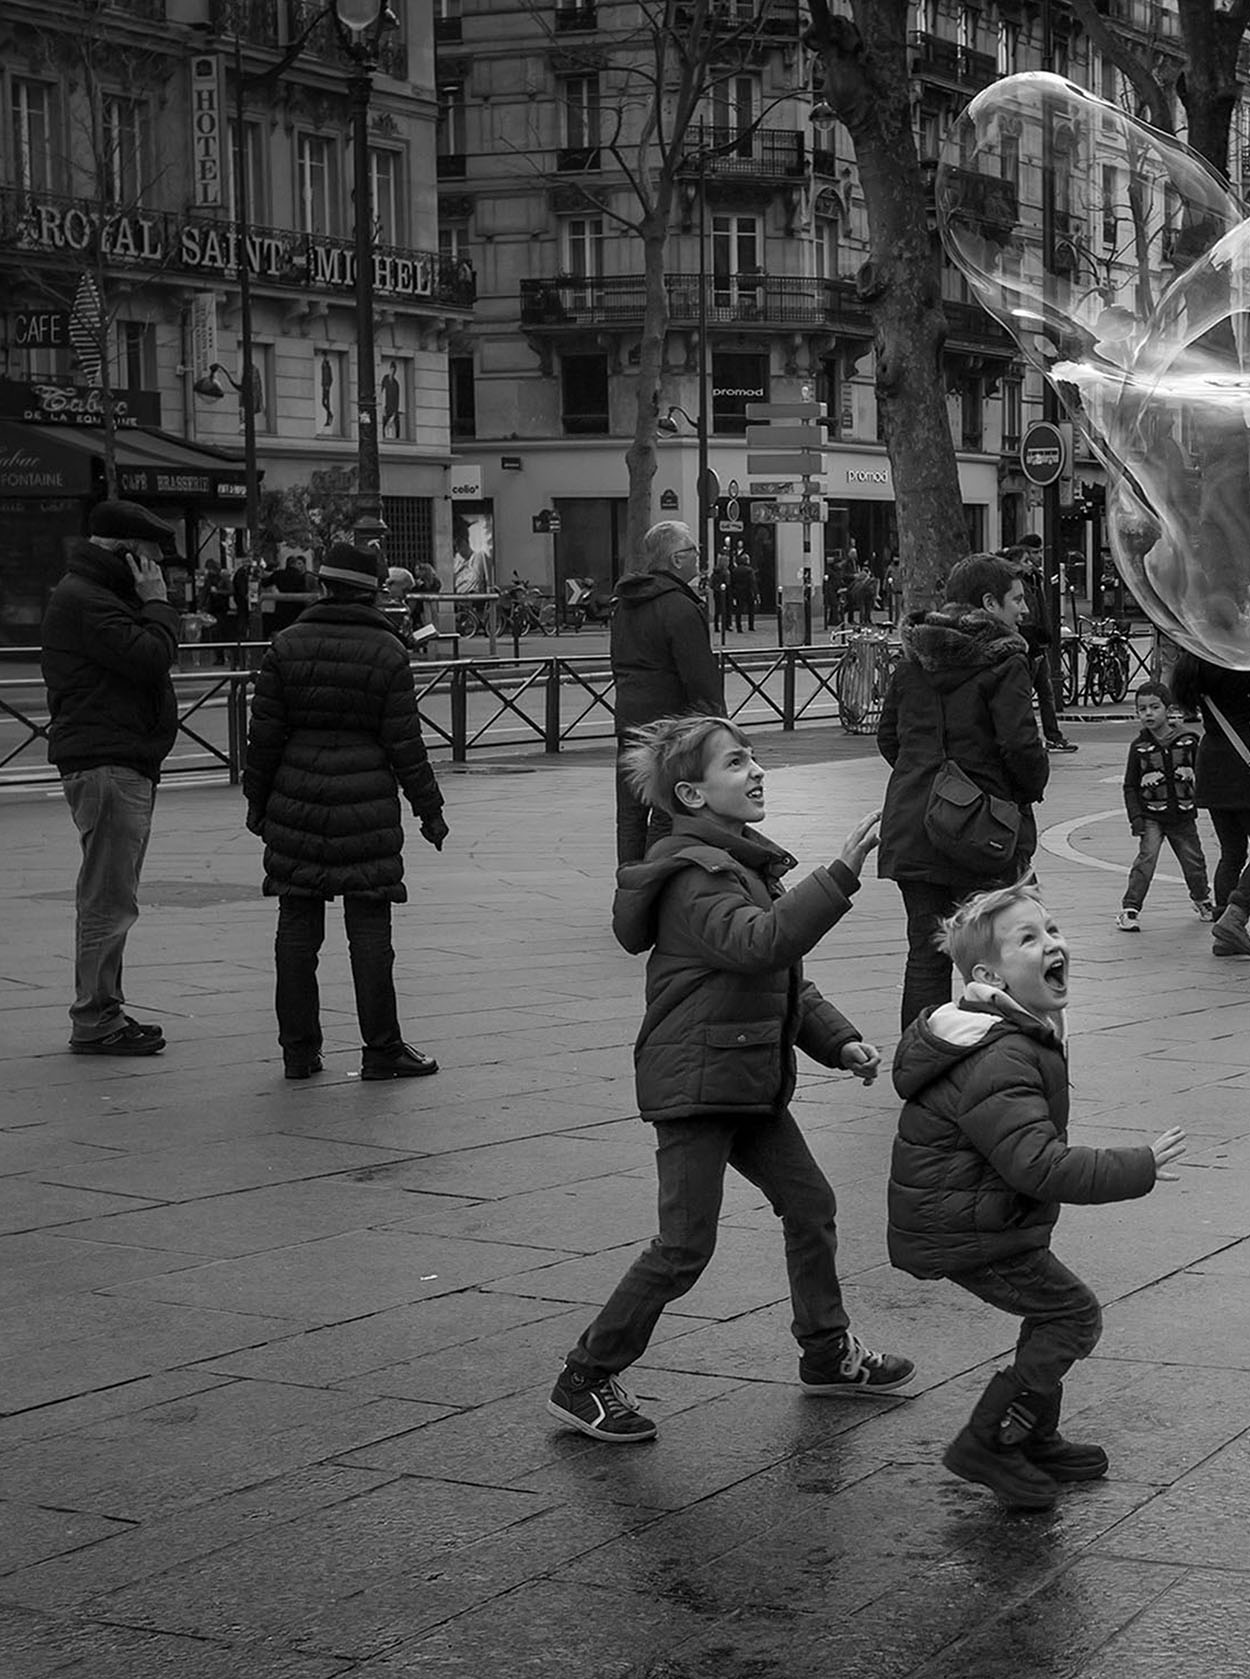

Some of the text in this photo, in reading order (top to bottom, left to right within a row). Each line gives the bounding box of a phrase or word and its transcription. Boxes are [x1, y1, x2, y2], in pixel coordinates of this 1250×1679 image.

[195, 88, 219, 204] HOTEL
[37, 205, 162, 260] ROYAL
[314, 245, 433, 296] MIHEL
[15, 313, 62, 345] CAFE
[712, 387, 764, 397] promod
[846, 469, 889, 484] promod
